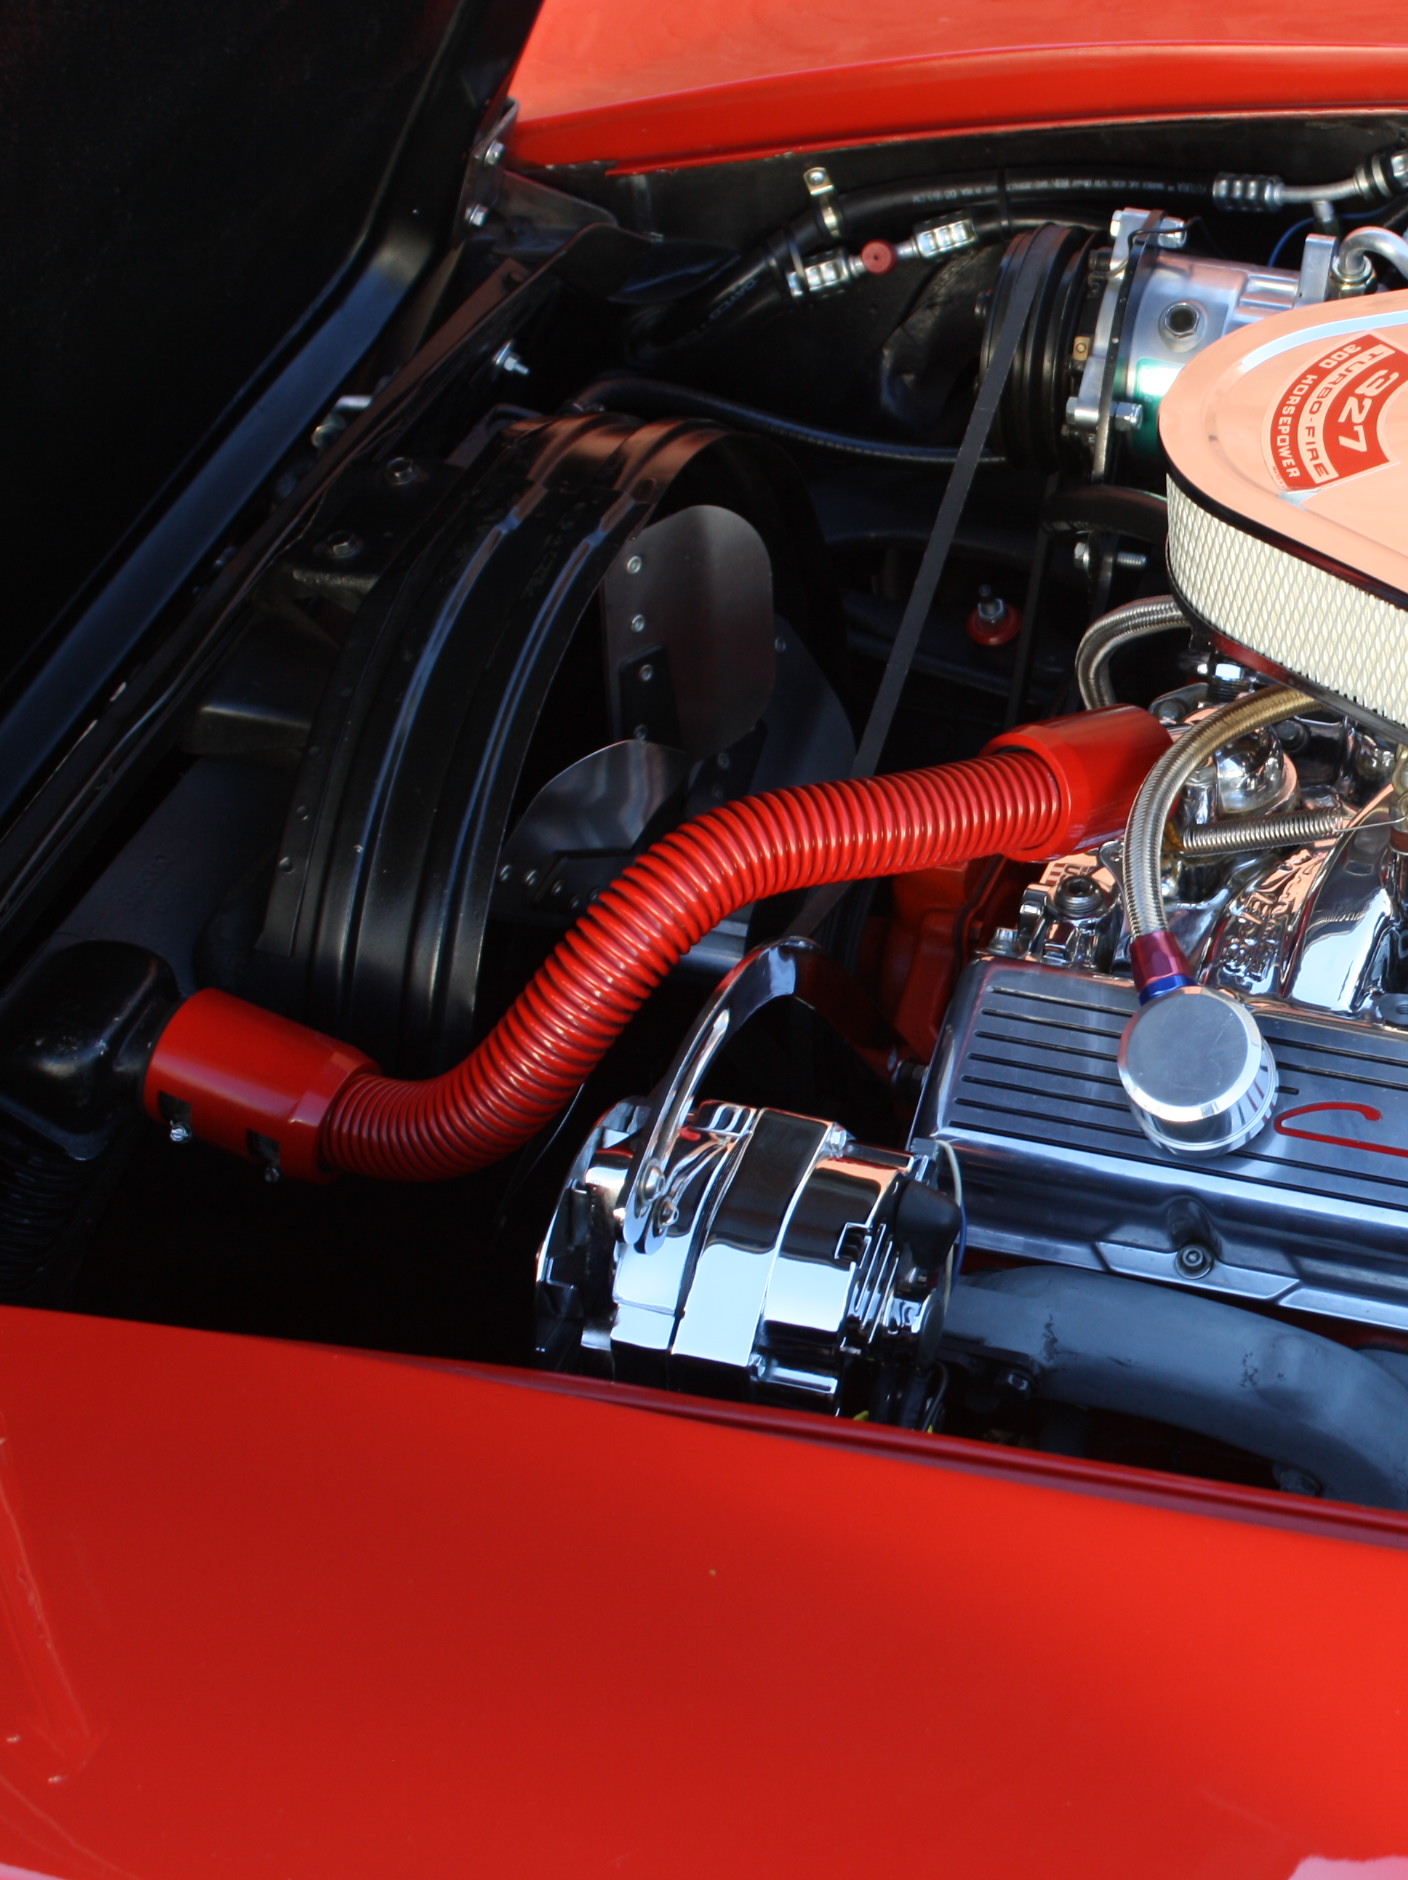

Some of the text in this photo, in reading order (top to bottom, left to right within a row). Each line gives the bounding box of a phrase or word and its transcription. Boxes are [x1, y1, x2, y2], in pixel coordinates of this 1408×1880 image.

[1276, 344, 1361, 478] 300 HORSEPOWER
[1304, 351, 1384, 478] TURBO-FIRE
[1338, 369, 1400, 453] 327
